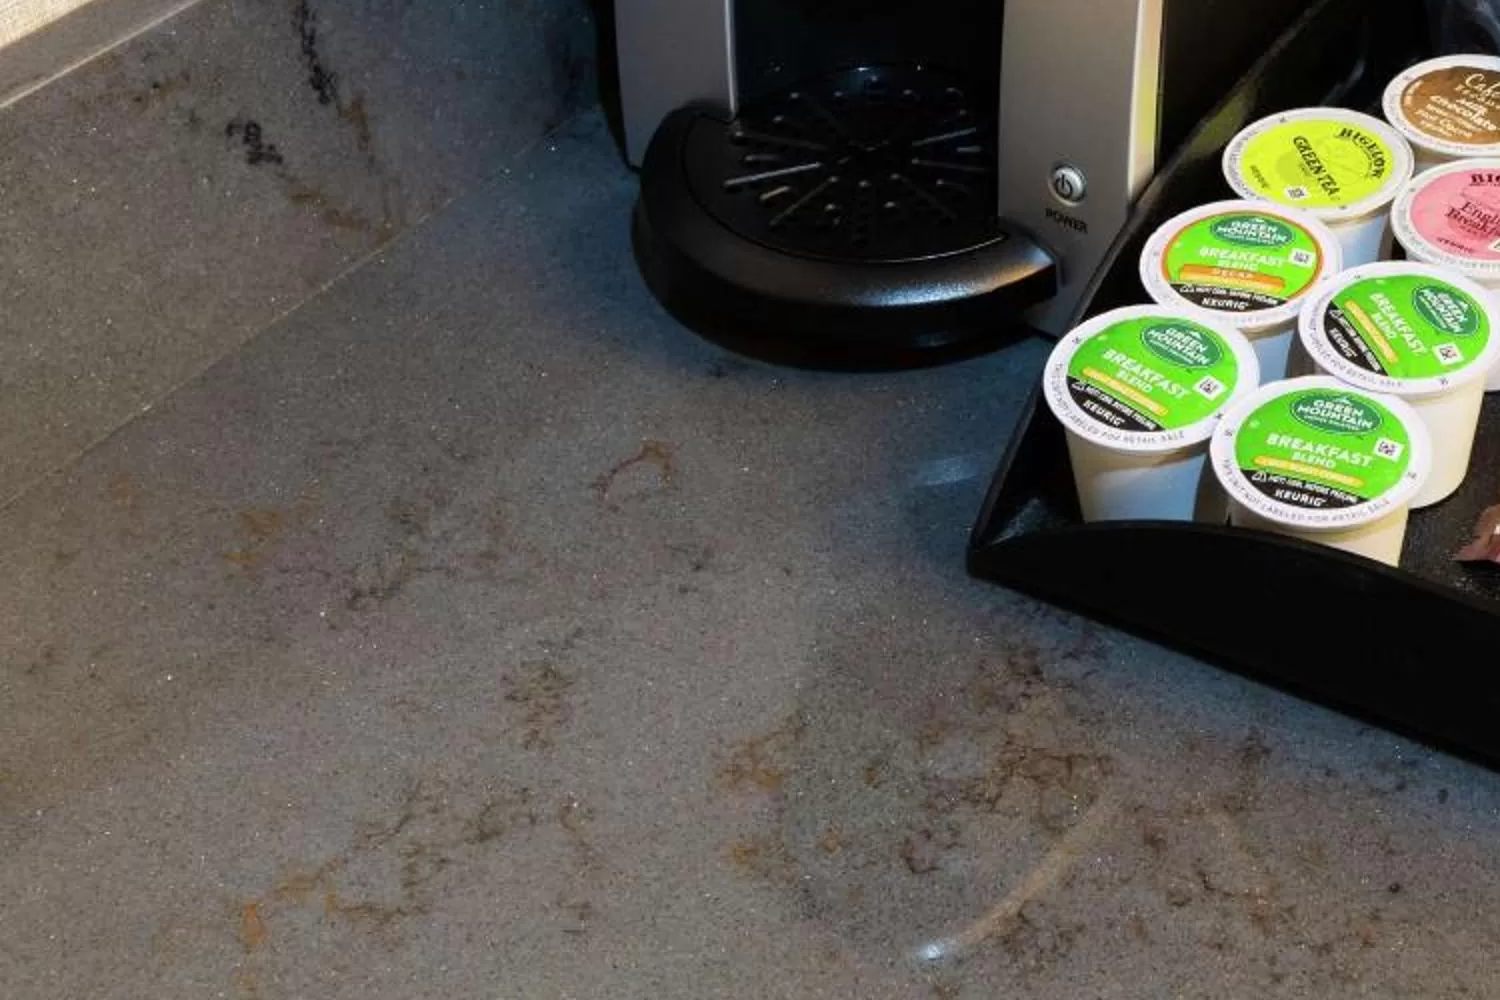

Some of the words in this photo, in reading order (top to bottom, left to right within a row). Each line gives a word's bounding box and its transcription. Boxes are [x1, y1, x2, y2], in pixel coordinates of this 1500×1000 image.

[1293, 136, 1325, 178] GREEN
[1318, 174, 1341, 196] TEA
[1103, 349, 1192, 399] BREAKFAST
[1083, 400, 1125, 427] KEURIG
[1298, 405, 1373, 429] MOUNTAIN
[1313, 399, 1364, 417] GREEN
[1266, 433, 1373, 466] BREAKFAST
[1291, 452, 1336, 469] BLEND
[1274, 489, 1324, 507] KEURIG
